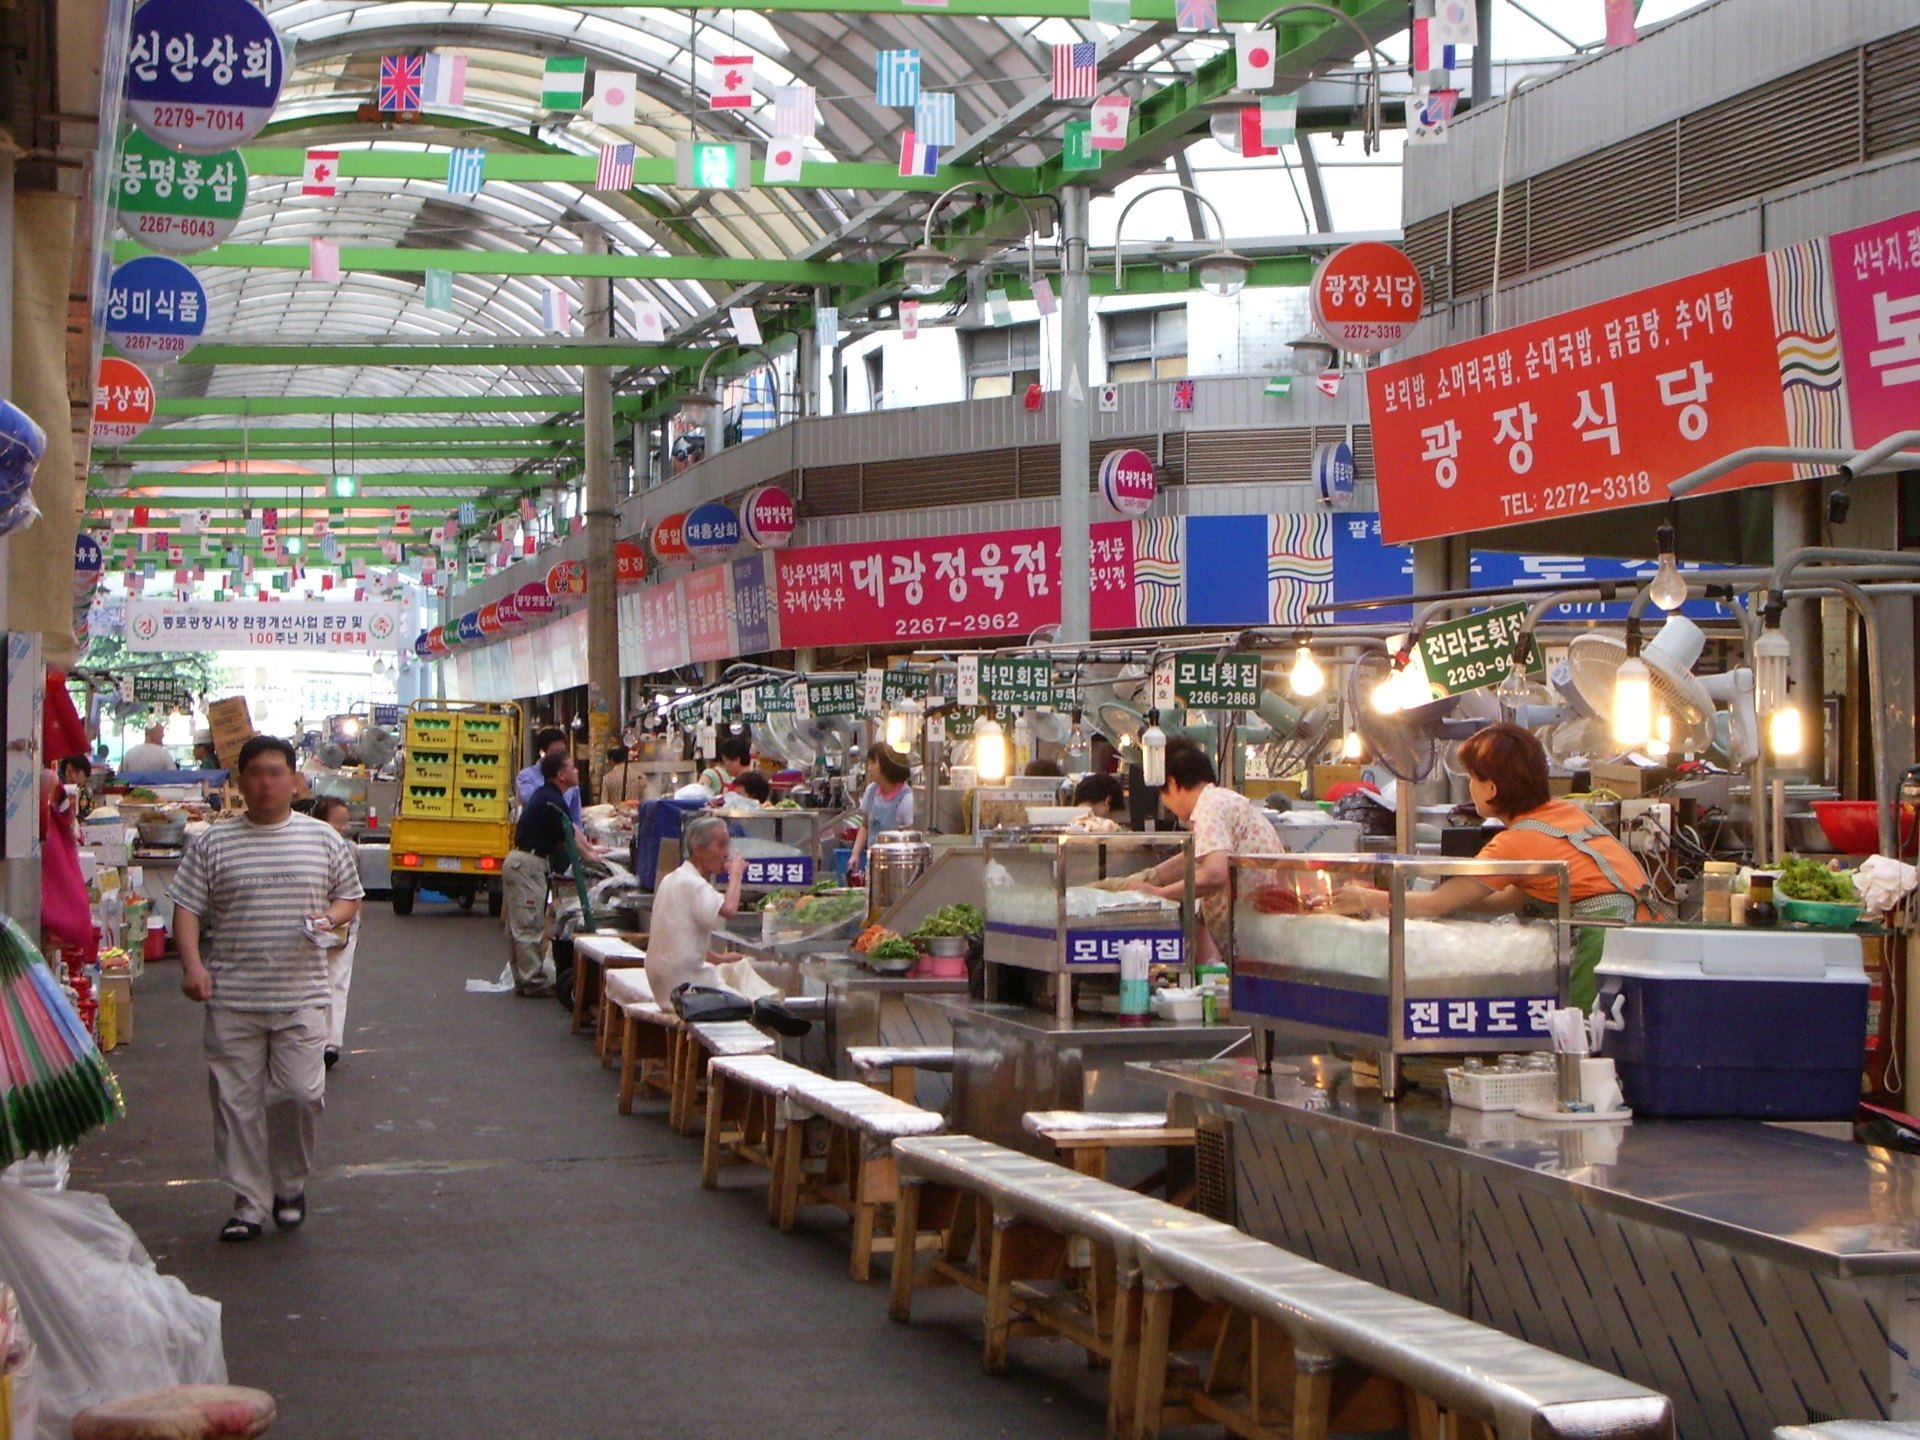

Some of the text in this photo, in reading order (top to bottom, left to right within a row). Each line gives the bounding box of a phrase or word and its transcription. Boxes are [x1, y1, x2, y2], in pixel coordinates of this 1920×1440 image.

[130, 30, 273, 88] 신안상회
[153, 107, 245, 131] 2279-7014
[121, 153, 238, 202] 동명홍삼
[139, 215, 215, 237] 2267-6043
[1325, 274, 1416, 308] 광장식당
[107, 291, 200, 323] 성미식품
[1676, 287, 1734, 341] 추어탕
[125, 334, 185, 351] 2267-2928
[1344, 324, 1401, 339] 2272-3318
[1118, 469, 1153, 489] 대광정육점
[1543, 471, 1651, 511] 2272-3318
[756, 505, 793, 524] 대광정육점
[688, 522, 738, 540] 대흥상회
[780, 560, 844, 587] 한우암돼지
[849, 540, 1049, 609] 대광정육점
[783, 588, 845, 615] 국내산육우
[163, 616, 239, 630] 종로광장시장
[895, 611, 1020, 637] 2267-2962
[249, 632, 298, 644] 100주년
[303, 632, 326, 644] 기념
[962, 675, 974, 684] 25
[1156, 675, 1170, 686] 24
[1179, 663, 1257, 688] 모녀횟집
[868, 686, 879, 695] 27
[991, 690, 1048, 702] 2267-5478
[1189, 691, 1256, 706] 2266-2868
[1410, 999, 1556, 1033] 전라도집
